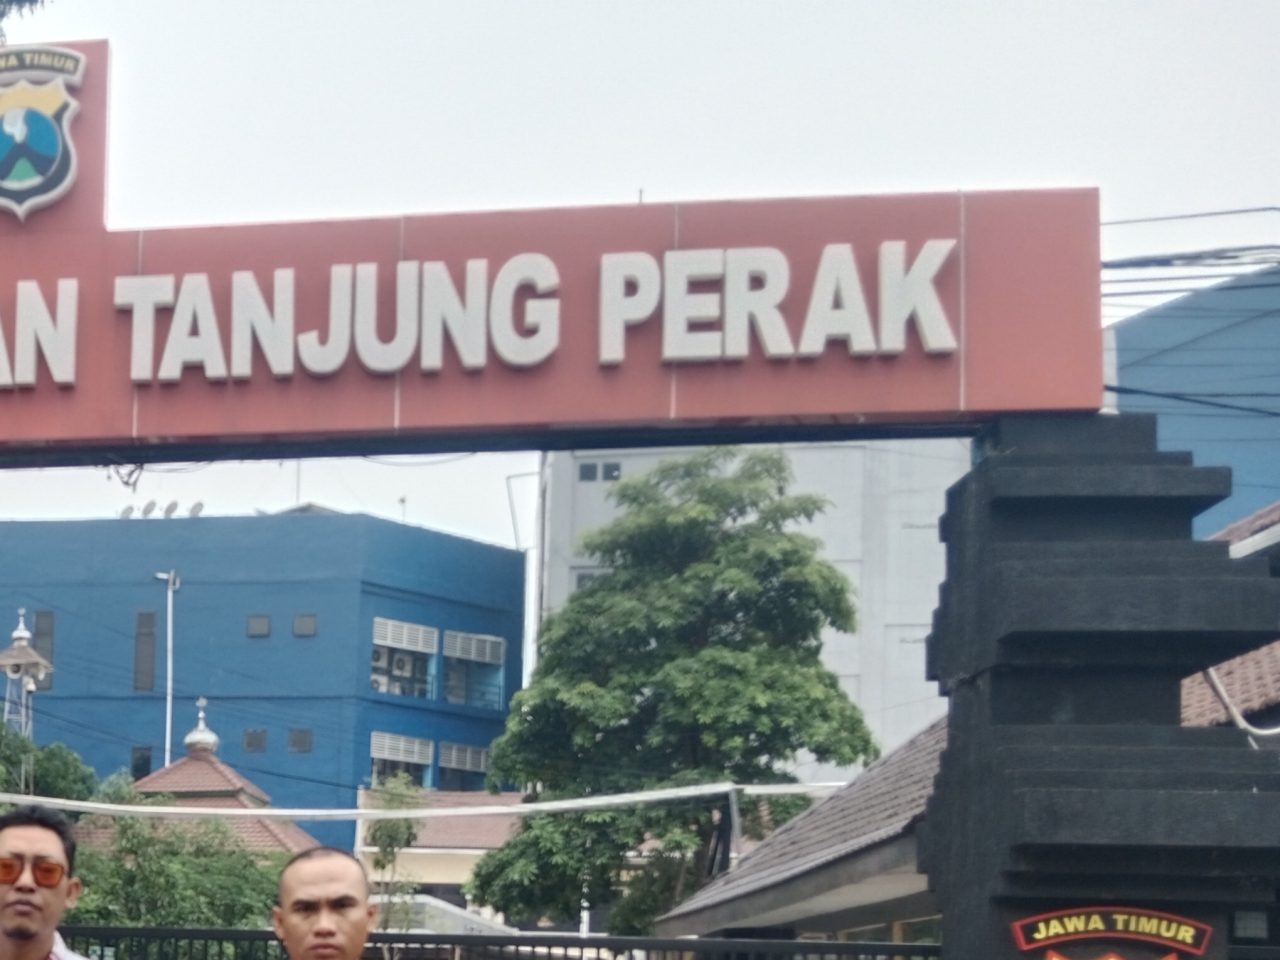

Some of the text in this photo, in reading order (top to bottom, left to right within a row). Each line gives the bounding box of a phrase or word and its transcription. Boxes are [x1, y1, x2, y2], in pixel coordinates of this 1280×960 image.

[23, 53, 77, 72] TIMUR
[114, 253, 560, 384] TANJUNG
[599, 239, 957, 366] PERAK
[1032, 914, 1196, 944] JAWA TIMUR
